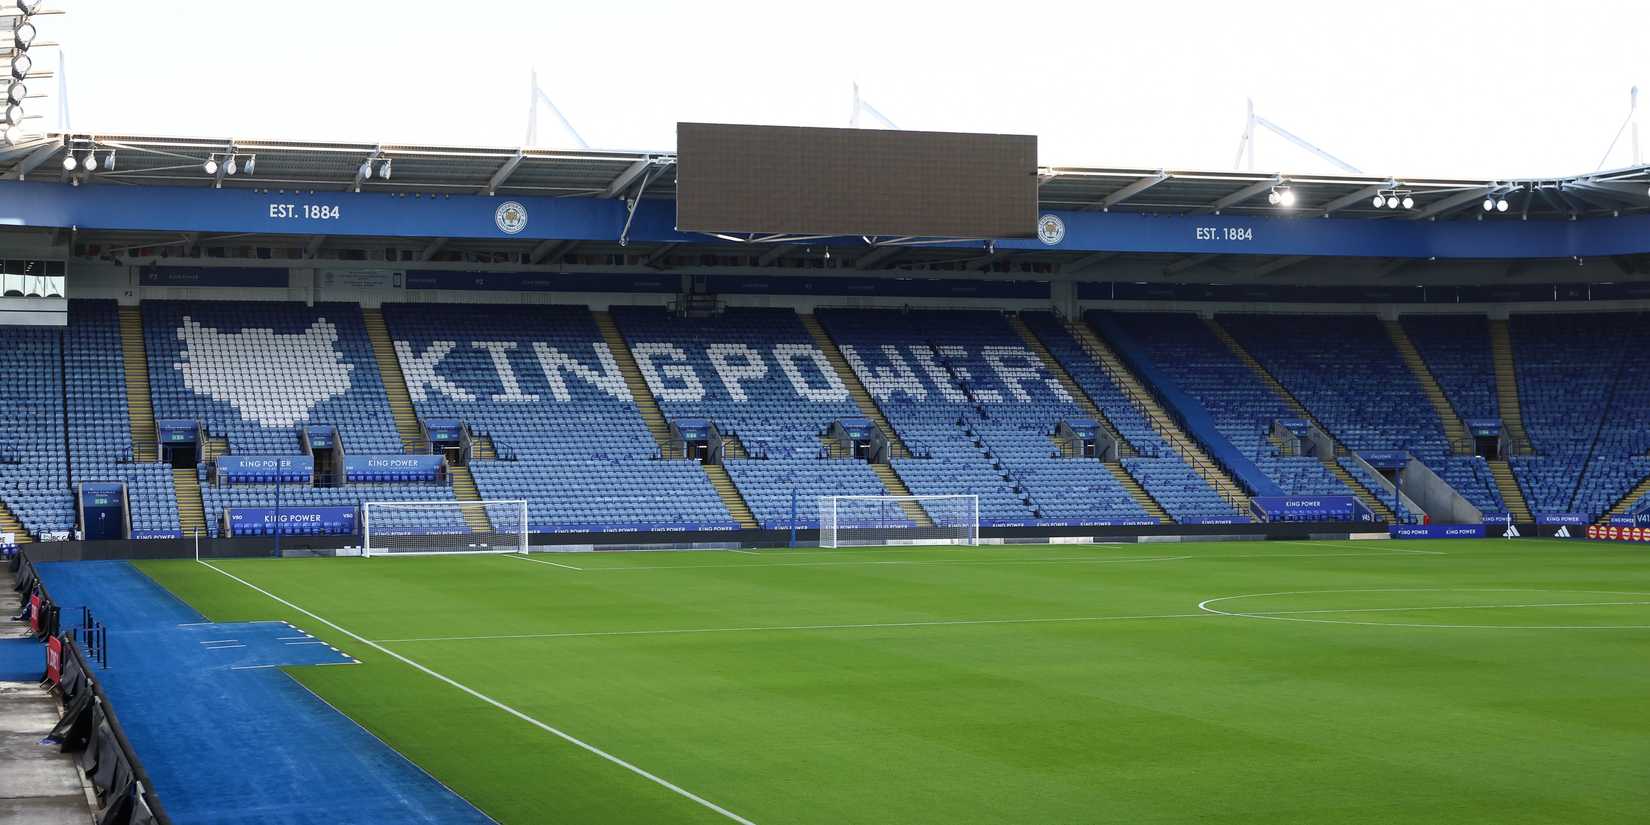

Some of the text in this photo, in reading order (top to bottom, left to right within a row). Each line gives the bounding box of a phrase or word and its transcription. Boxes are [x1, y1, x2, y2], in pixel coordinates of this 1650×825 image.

[269, 204, 340, 220] EST. 1884
[1196, 227, 1253, 241] EST. 1884
